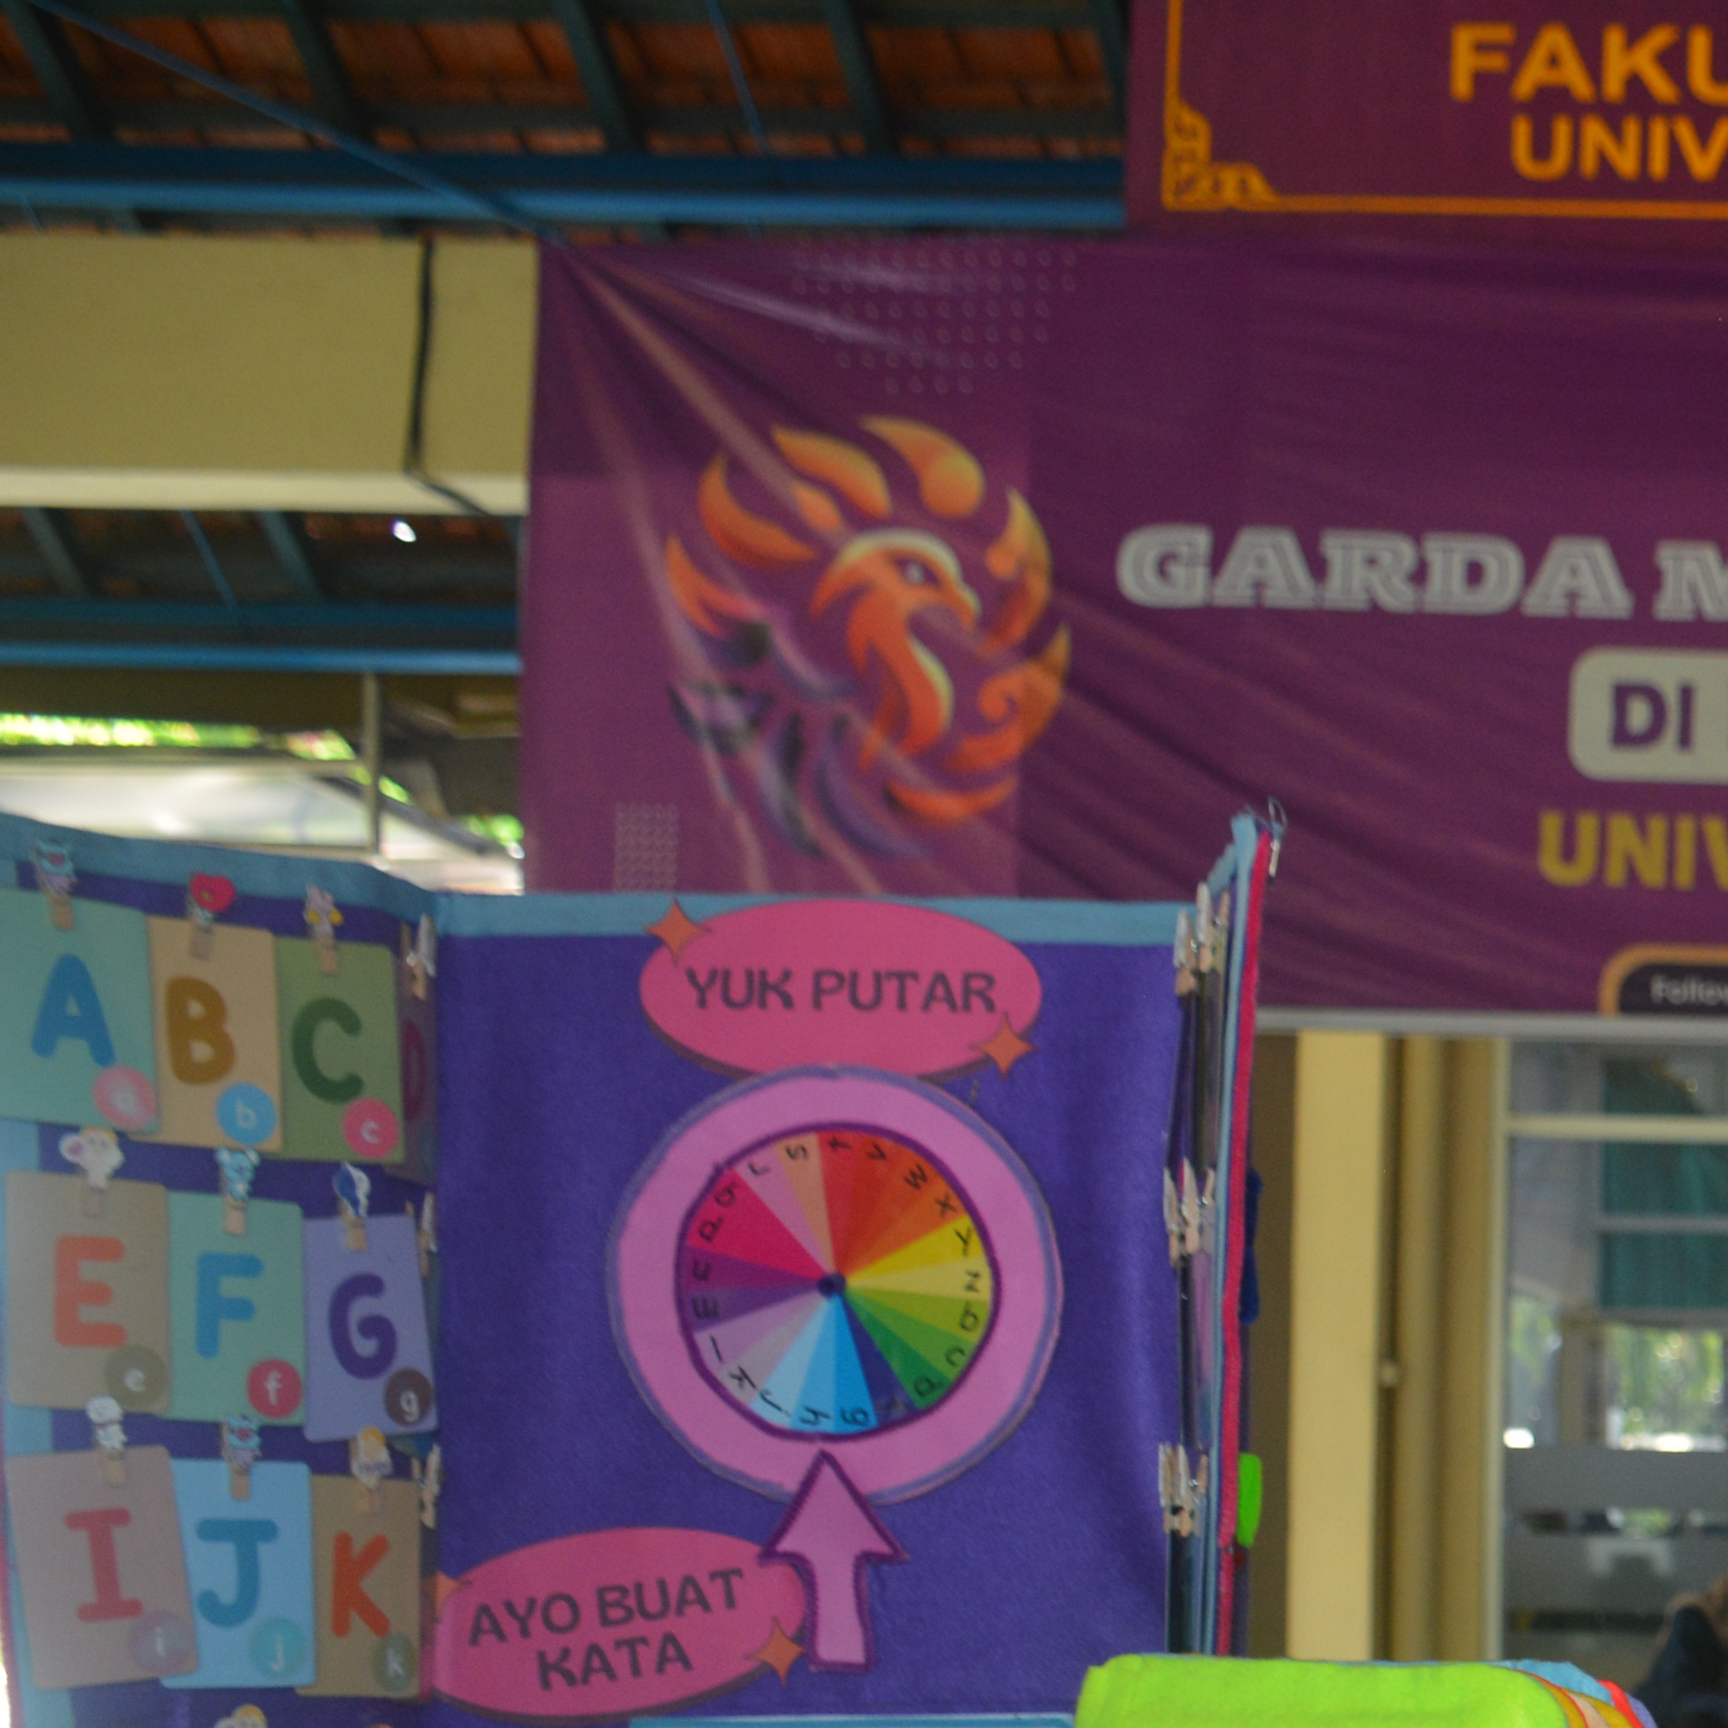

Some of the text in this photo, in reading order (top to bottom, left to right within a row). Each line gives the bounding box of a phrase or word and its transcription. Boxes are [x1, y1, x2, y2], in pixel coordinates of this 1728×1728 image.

[1116, 523, 1631, 621] GARDA
[1609, 681, 1695, 752] DI
[686, 968, 997, 1014] YUK PUTAR
[31, 954, 363, 1104] A B C
[237, 1100, 257, 1128] b
[54, 1235, 398, 1380] E F G
[66, 1507, 391, 1638] I J K
[468, 1570, 744, 1645] AYO BUAT
[536, 1632, 692, 1690] KATA
